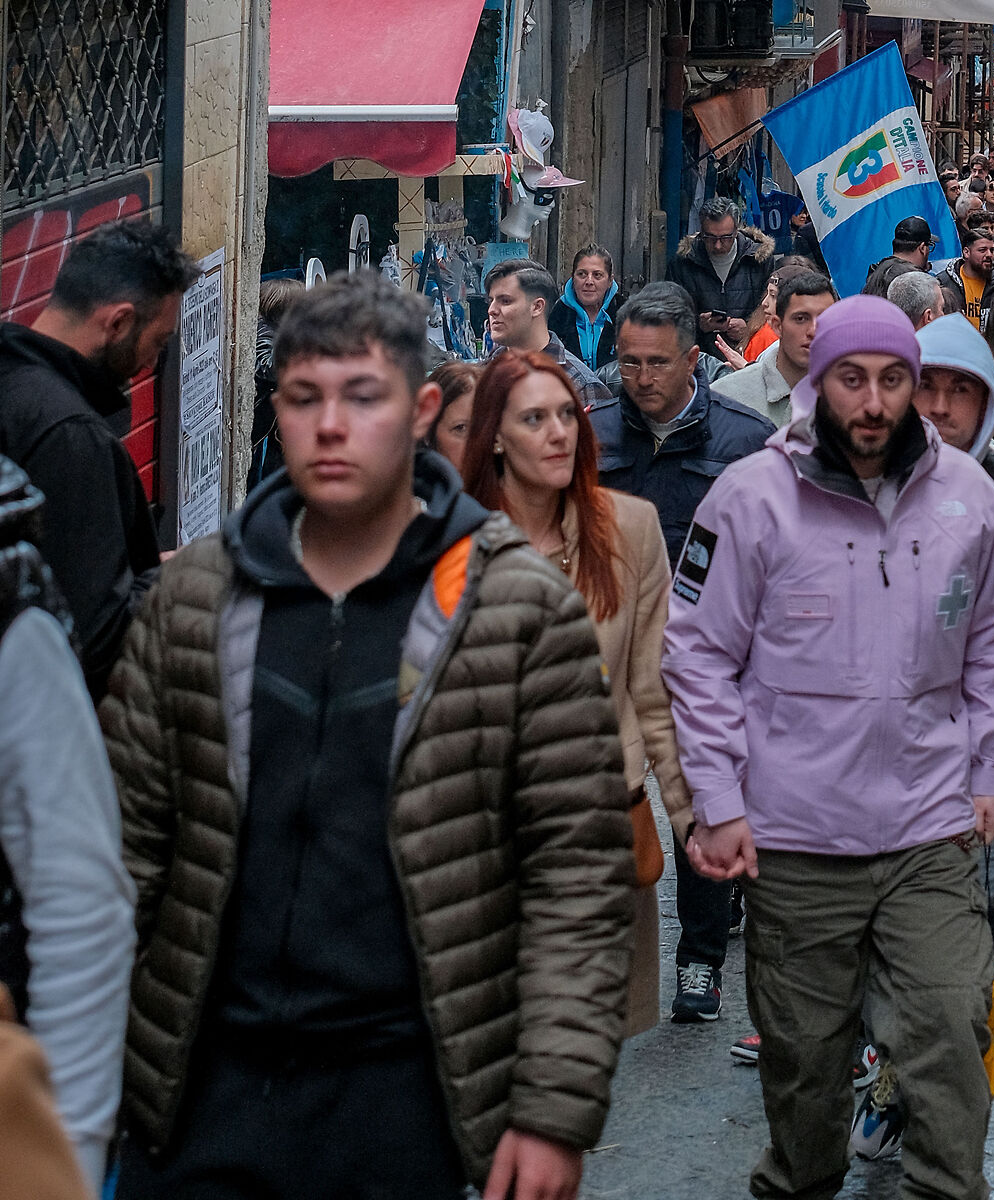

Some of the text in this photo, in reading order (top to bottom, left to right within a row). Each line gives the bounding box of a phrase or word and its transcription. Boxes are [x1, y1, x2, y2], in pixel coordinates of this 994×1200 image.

[847, 150, 884, 187] 3
[889, 126, 915, 173] D'ITALIA
[902, 117, 929, 175] CAMPIONE
